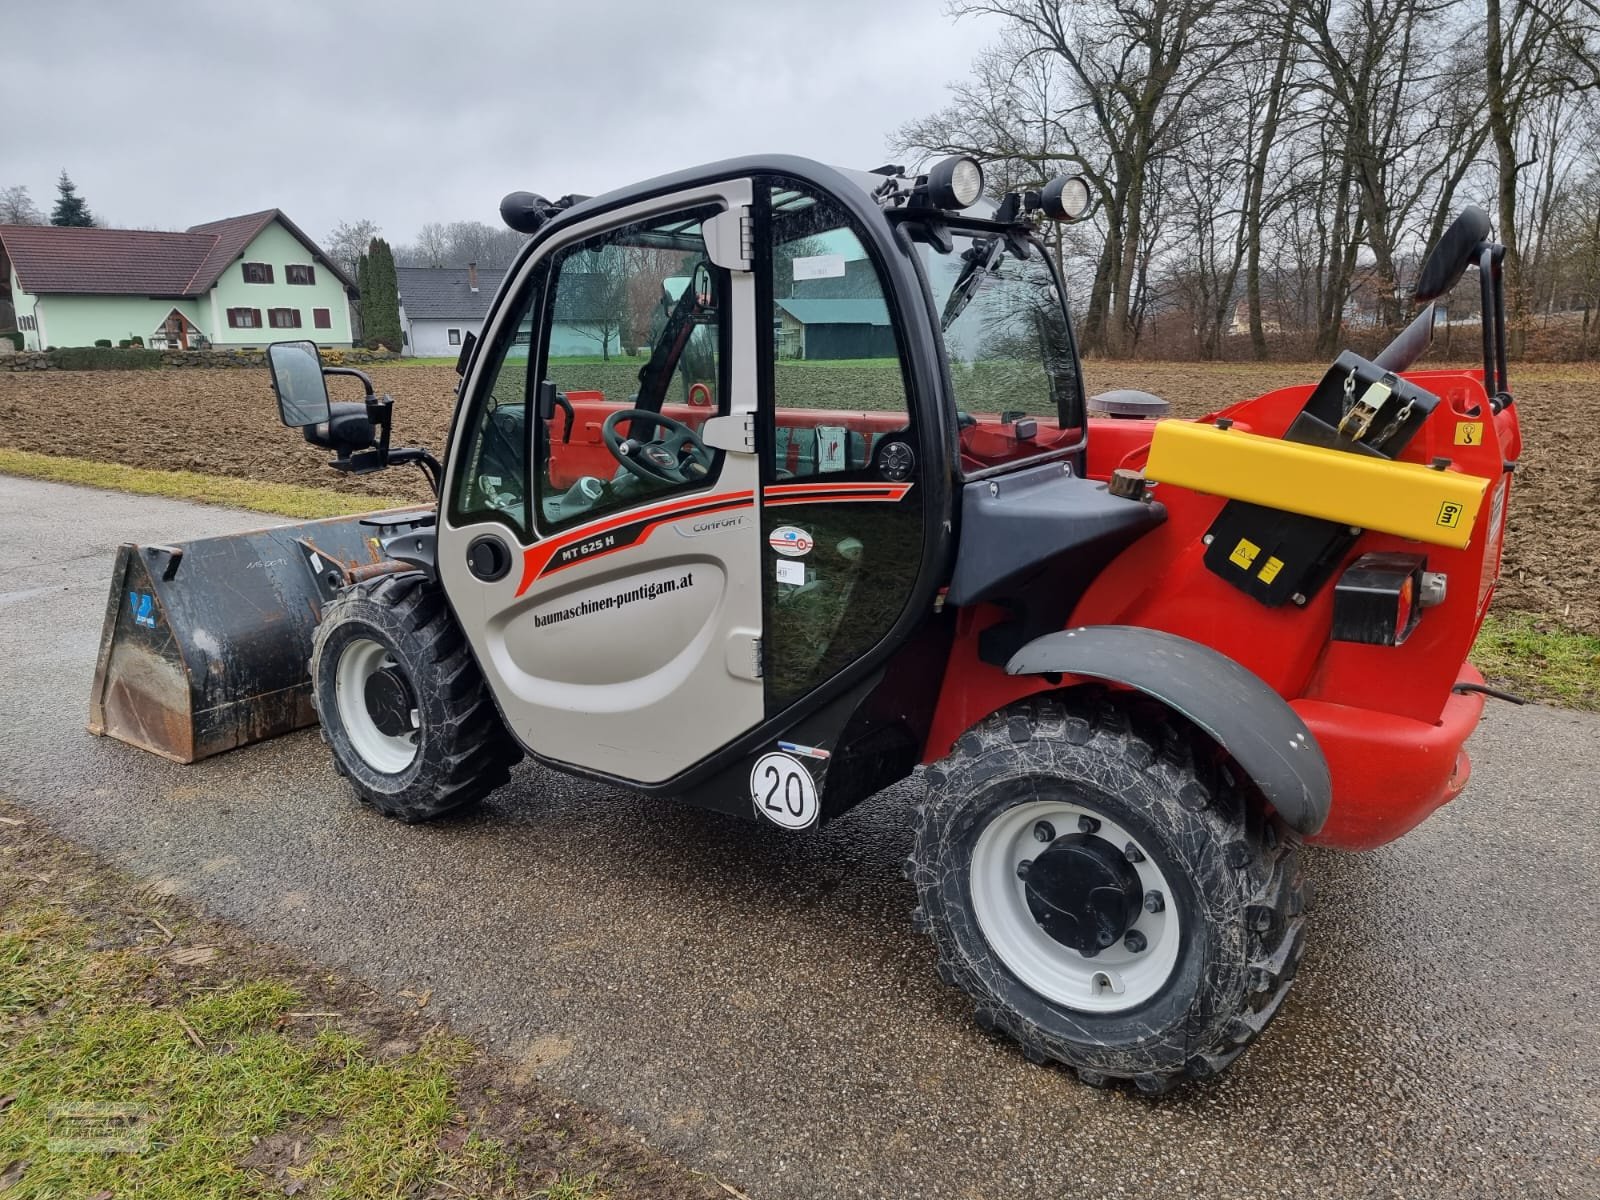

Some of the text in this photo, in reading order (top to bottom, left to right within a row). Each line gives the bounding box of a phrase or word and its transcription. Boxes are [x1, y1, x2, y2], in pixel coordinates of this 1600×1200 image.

[562, 535, 615, 561] MT 625 H
[534, 572, 693, 628] baumaschinen-puntigam.at
[765, 765, 804, 818] 20
